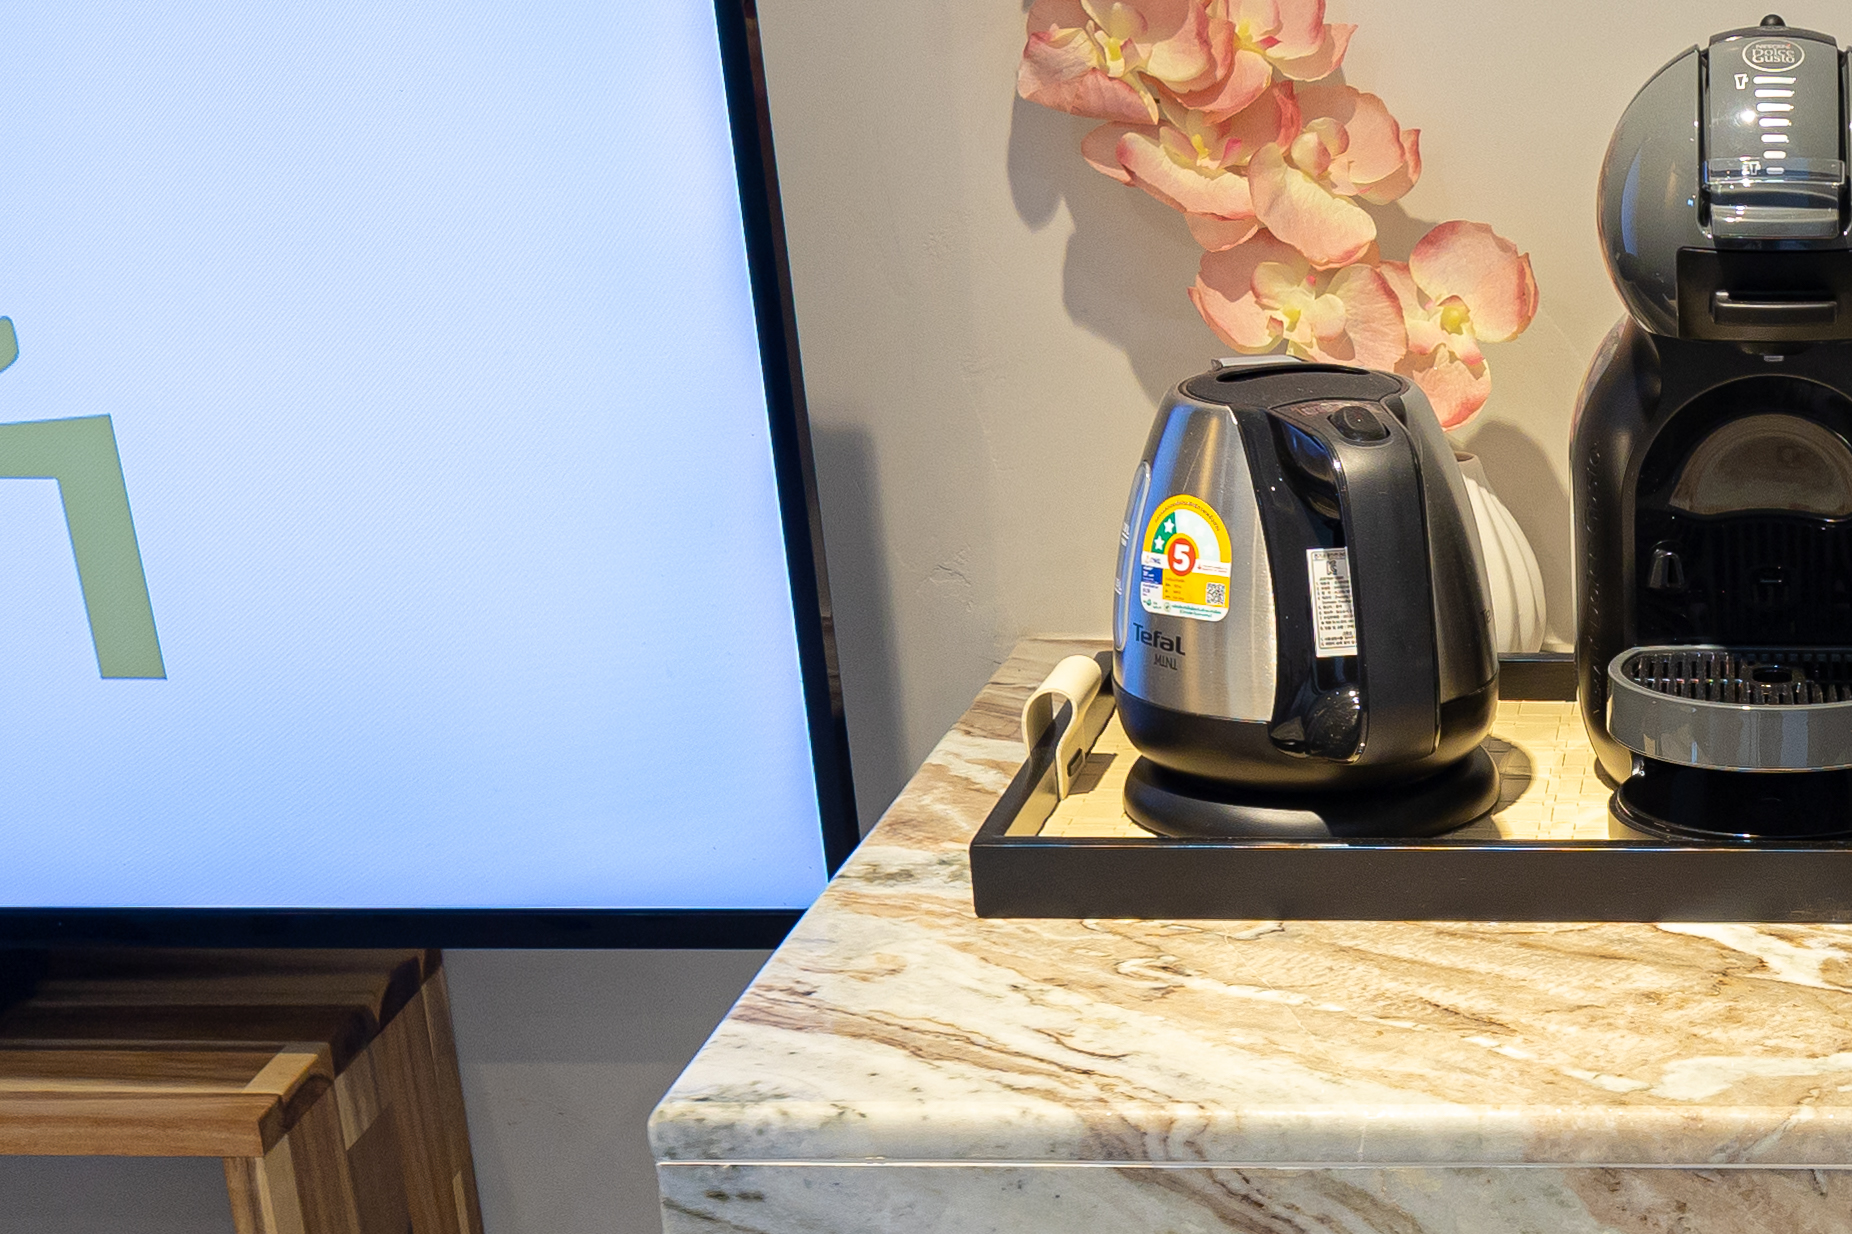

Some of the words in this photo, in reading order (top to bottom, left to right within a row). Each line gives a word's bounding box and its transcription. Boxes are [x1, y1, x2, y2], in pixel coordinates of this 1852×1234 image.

[1752, 48, 1795, 57] Dolce
[1752, 55, 1795, 63] Gusto
[1172, 543, 1190, 572] 5
[1133, 622, 1186, 656] Tefal
